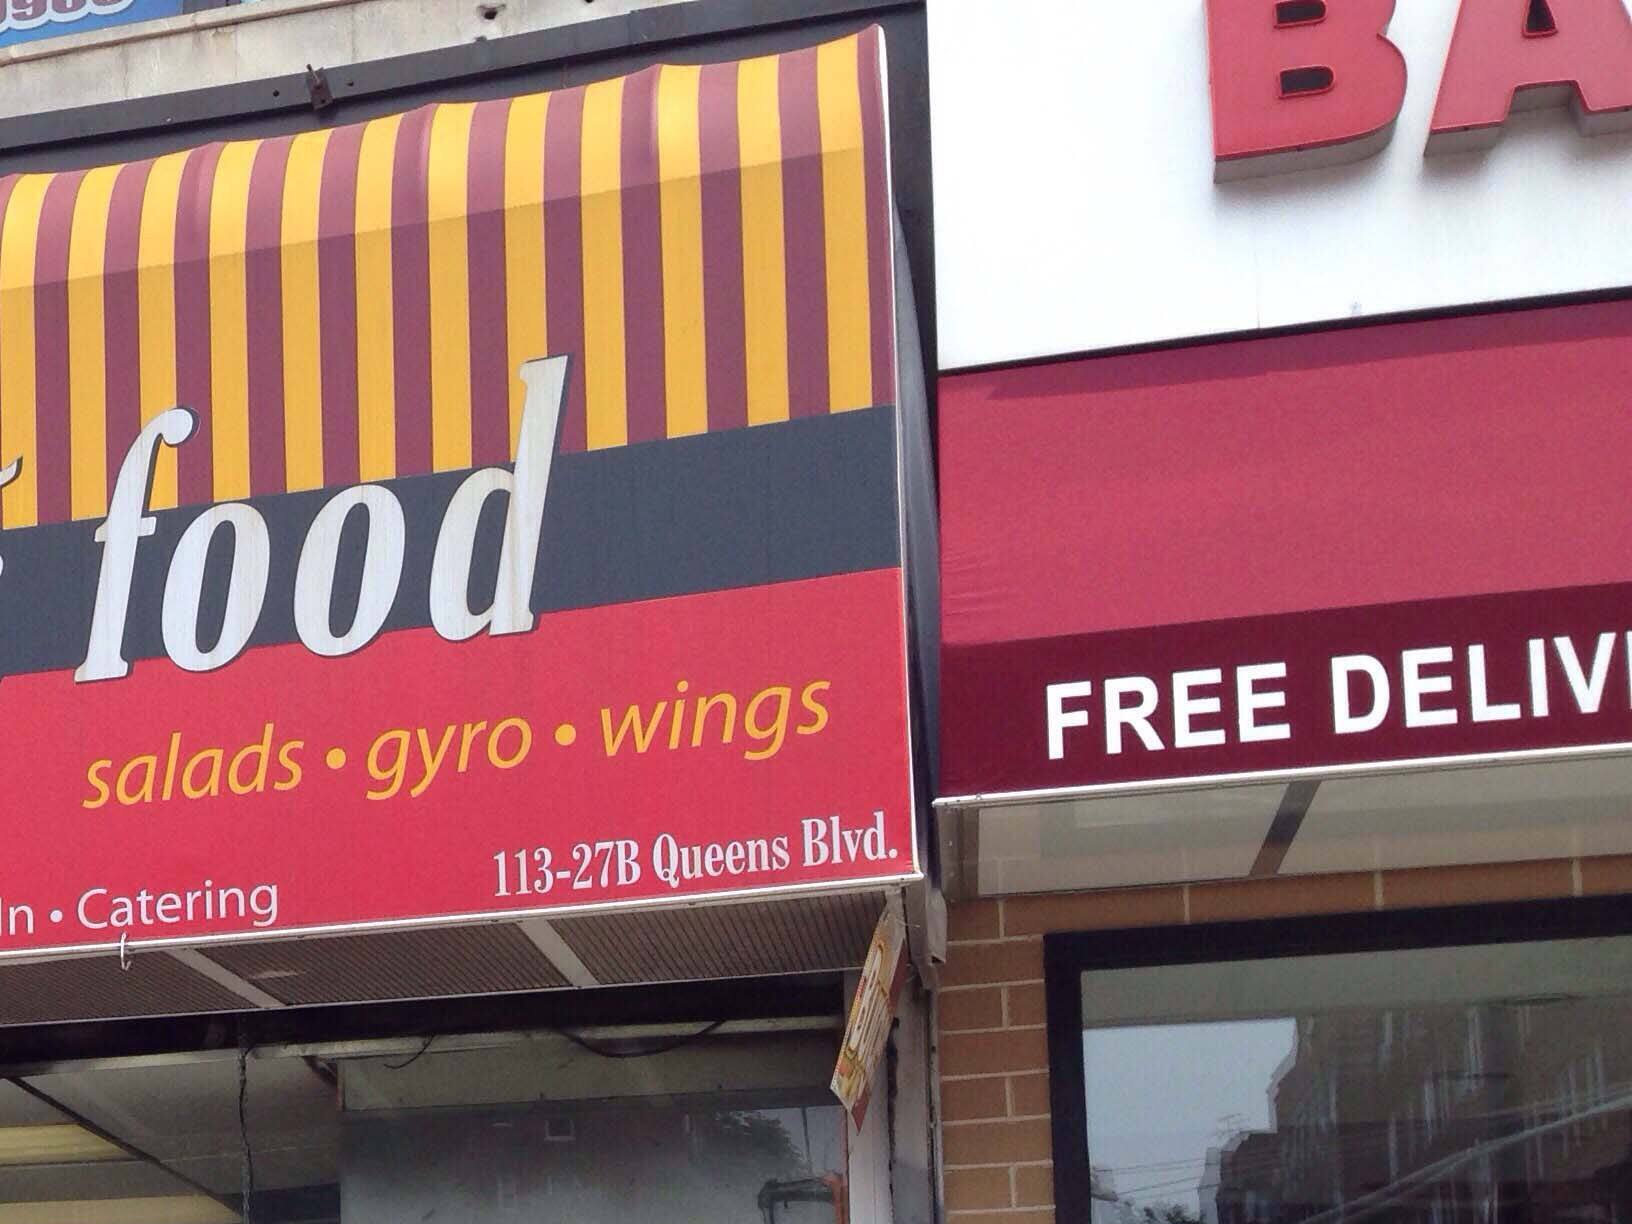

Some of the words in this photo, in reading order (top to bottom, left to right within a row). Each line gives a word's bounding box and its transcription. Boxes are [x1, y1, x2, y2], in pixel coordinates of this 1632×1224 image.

[72, 354, 570, 684] food
[82, 722, 305, 809] salads
[366, 717, 533, 801] gyro
[600, 678, 832, 762] wings
[1045, 661, 1291, 761] FREE
[1330, 631, 1632, 735] DELIV
[77, 880, 280, 930] Catering
[494, 839, 641, 898] 113-27B
[652, 833, 791, 889] Queens
[801, 810, 900, 868] Blvd.
